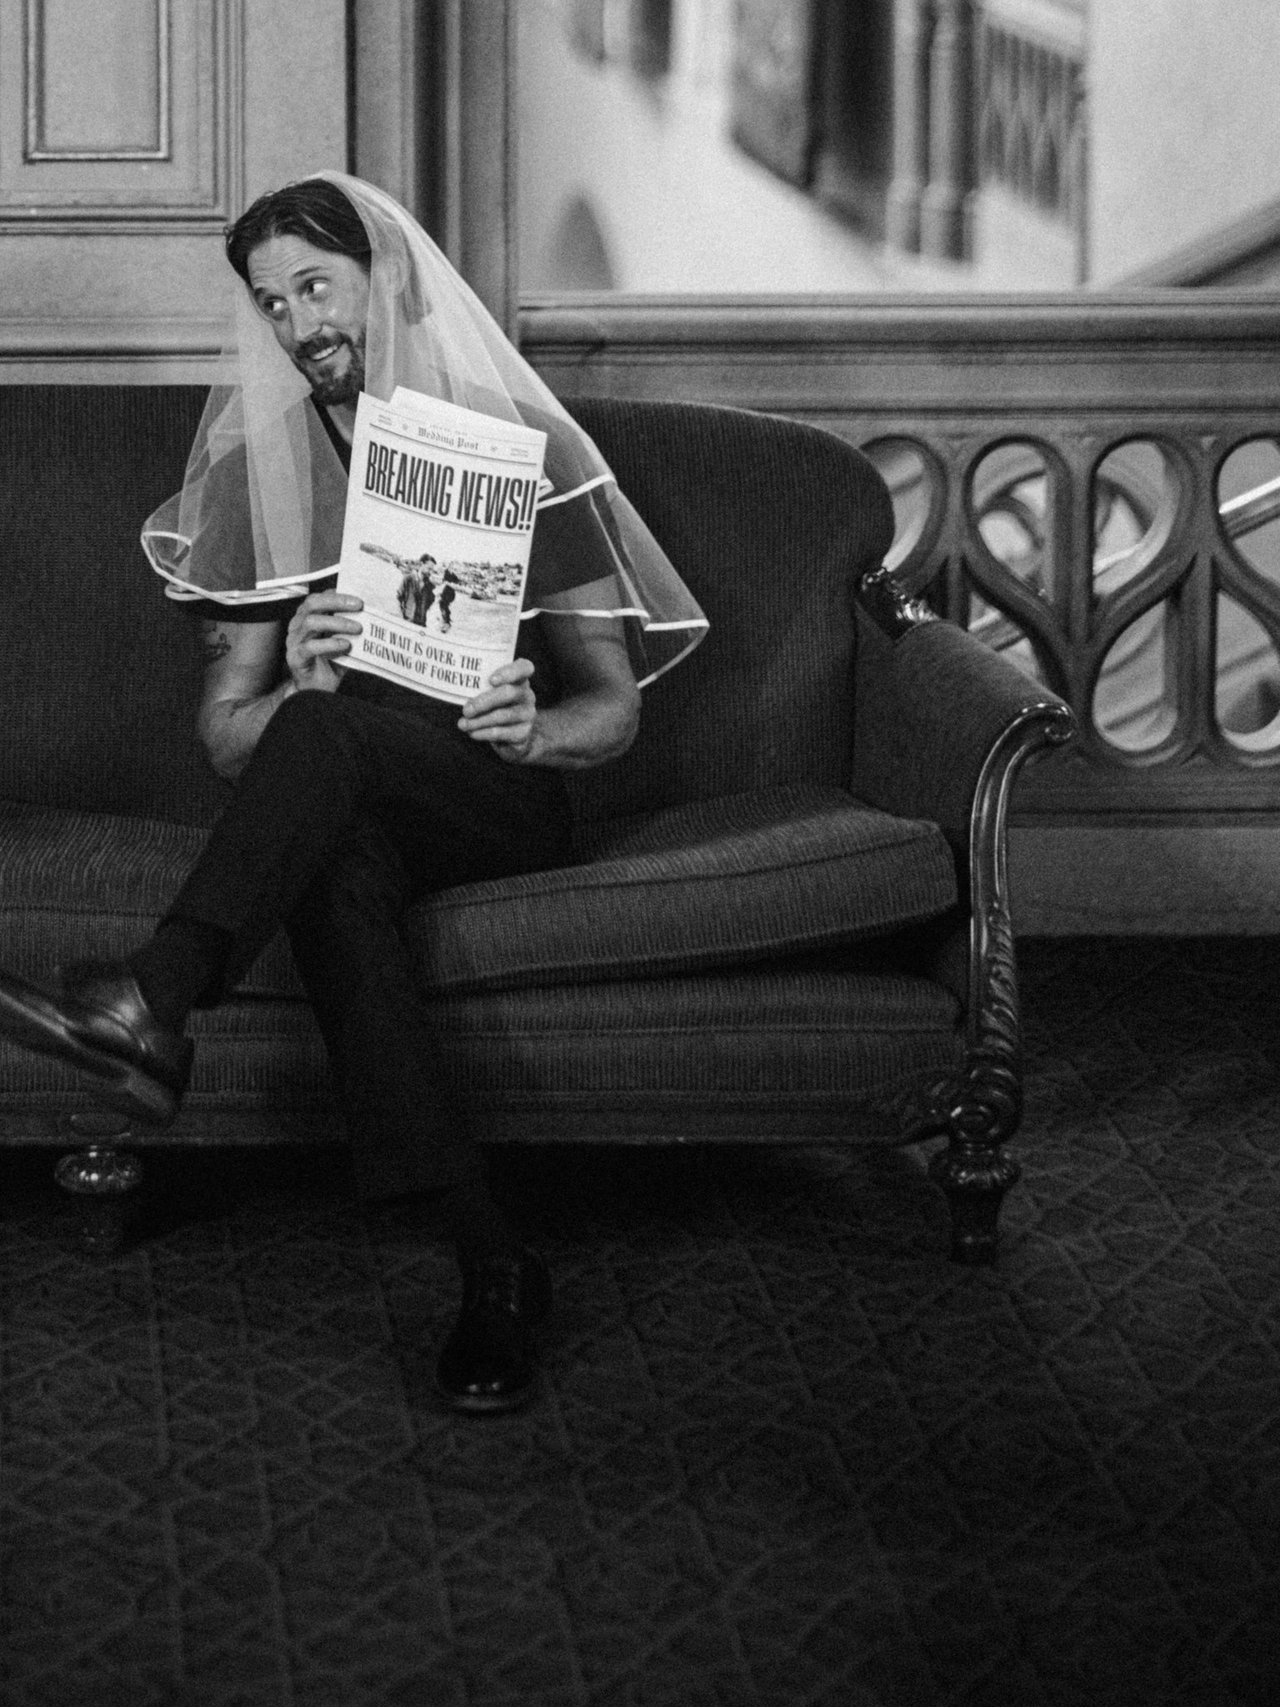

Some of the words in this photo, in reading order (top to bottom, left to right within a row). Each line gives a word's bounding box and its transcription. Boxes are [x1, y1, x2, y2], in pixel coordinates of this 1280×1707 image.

[417, 427, 455, 446] Wedding
[457, 437, 479, 450] Post
[365, 441, 455, 517] BREAKING
[456, 469, 538, 531] NEWS!!
[363, 639, 412, 670] BEGINNING
[415, 660, 429, 675] OF
[430, 665, 481, 689] FOREVER
[370, 623, 387, 641] THE
[389, 631, 412, 651] WAIT
[414, 641, 423, 656] IS
[425, 645, 455, 666] OVER:
[460, 655, 483, 672] THE
